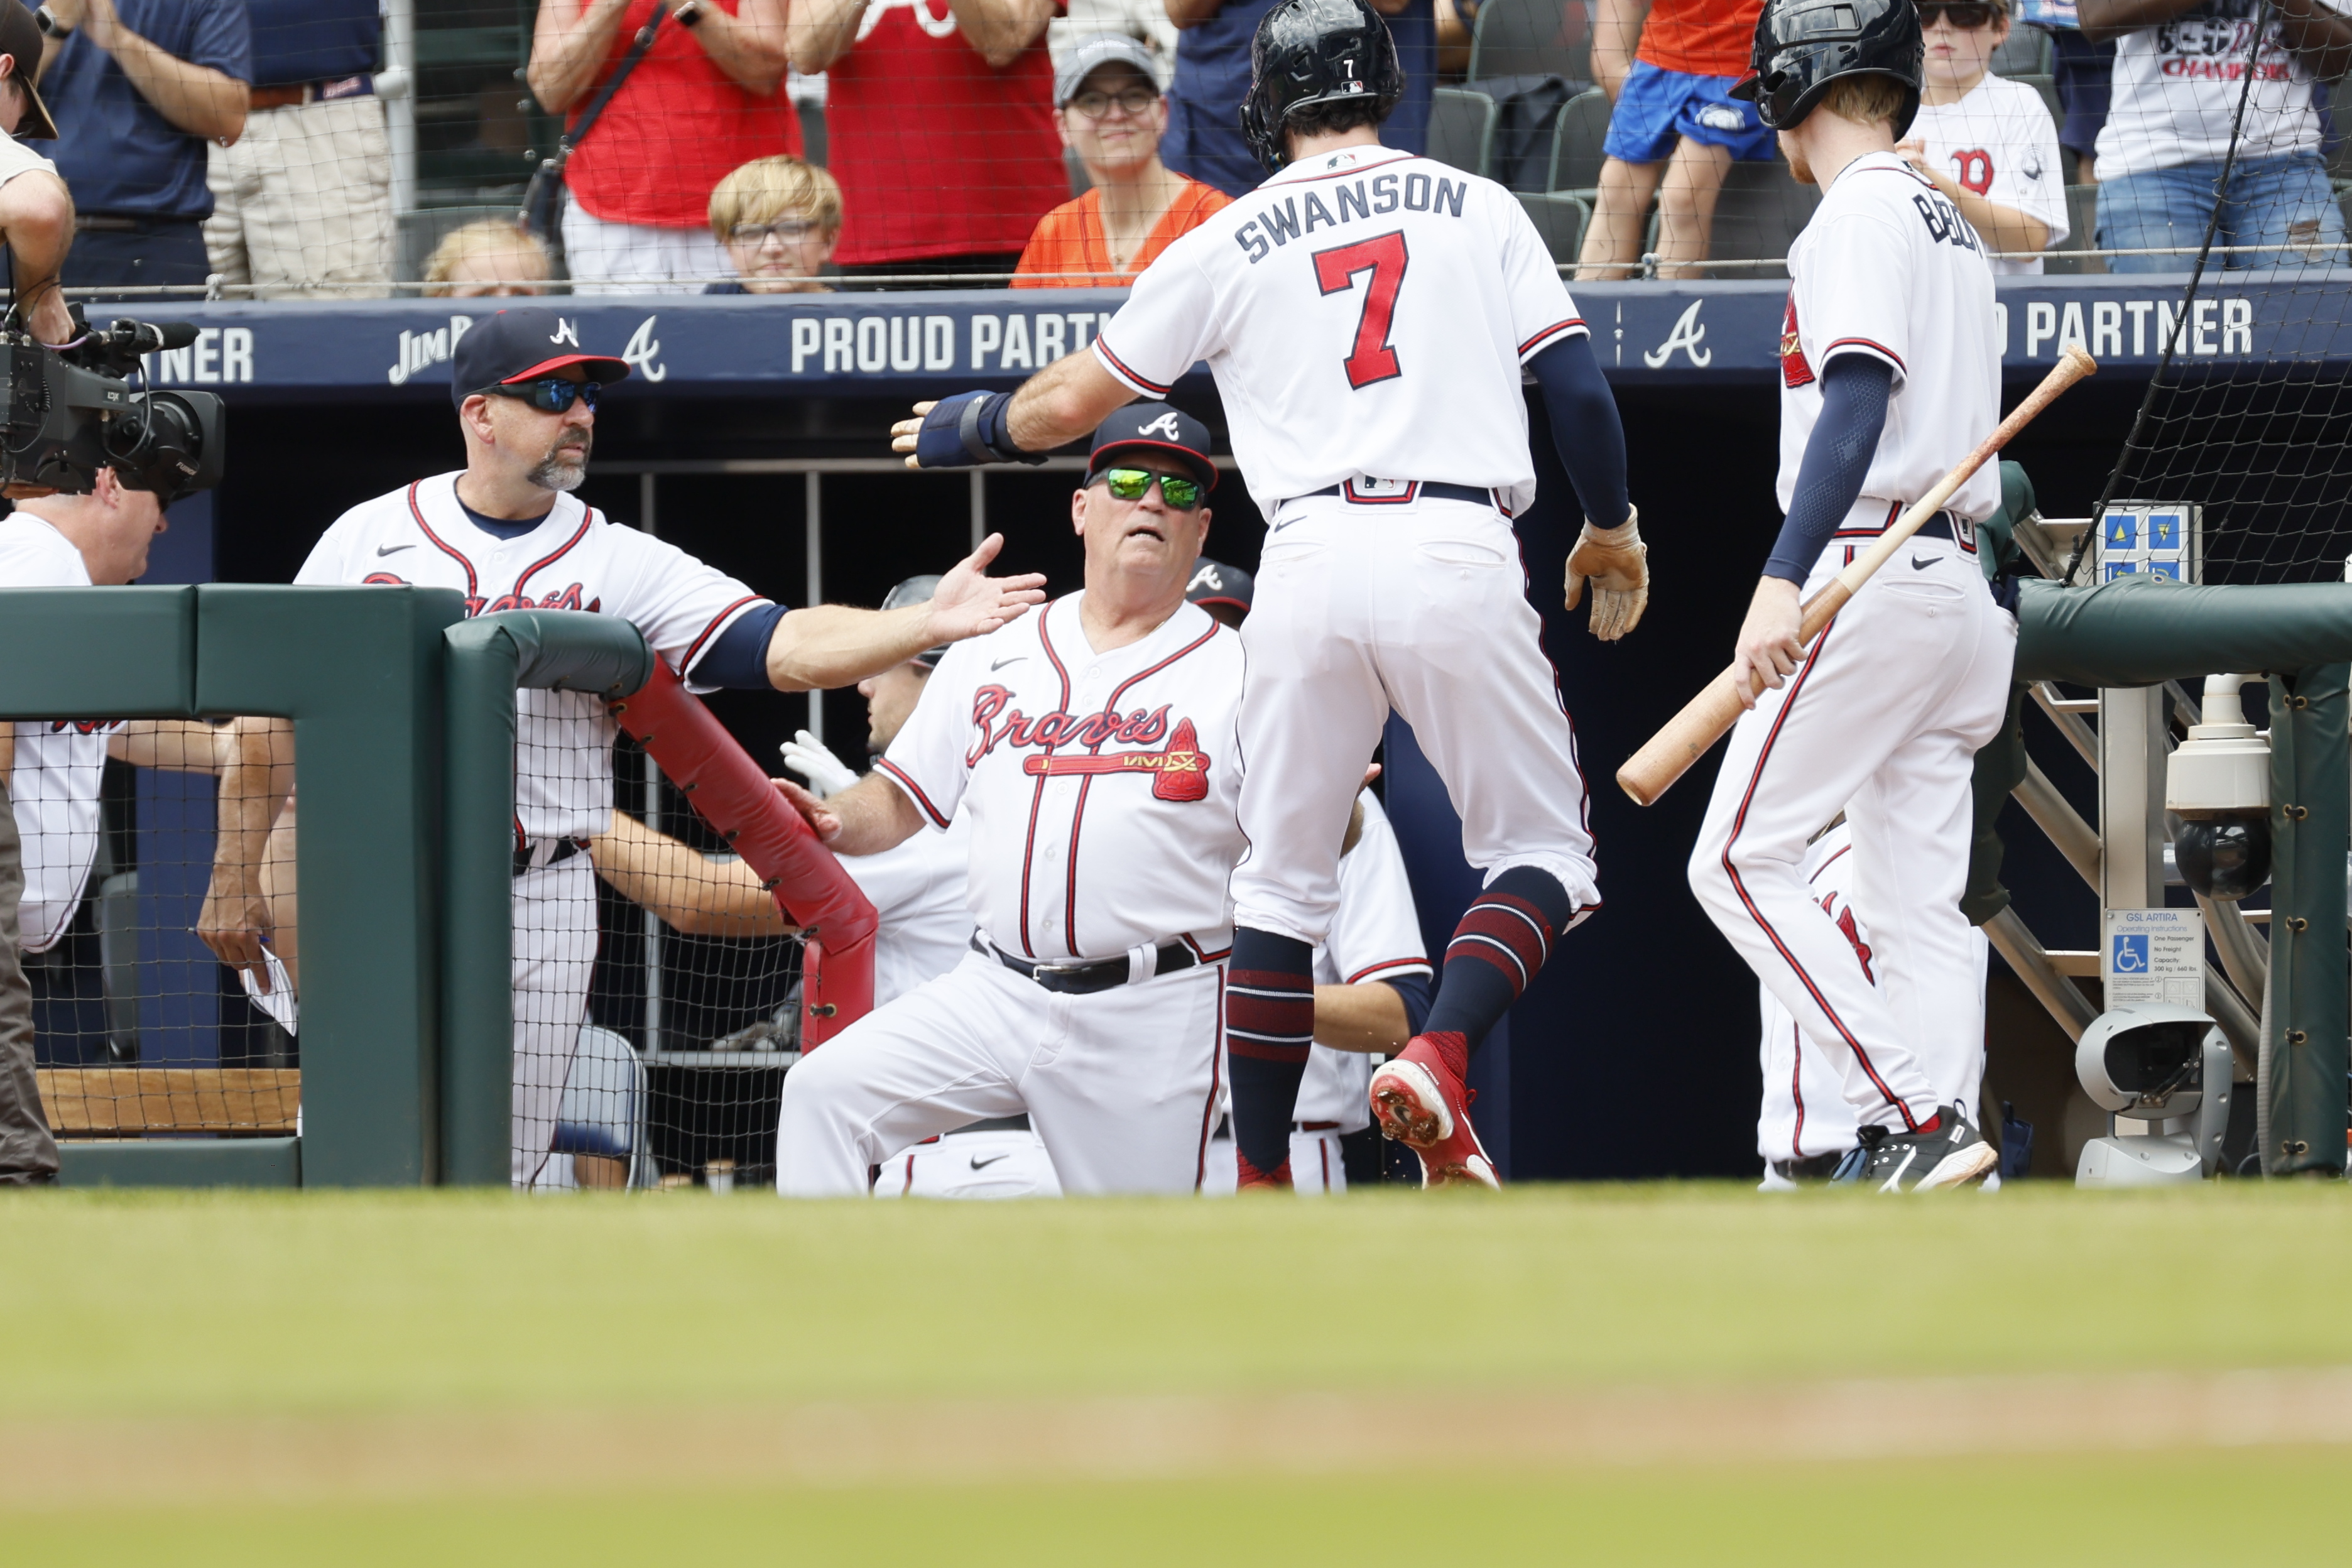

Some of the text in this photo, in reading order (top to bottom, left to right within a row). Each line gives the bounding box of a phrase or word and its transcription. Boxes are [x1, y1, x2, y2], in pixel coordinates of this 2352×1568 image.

[1344, 59, 1353, 79] 7
[1234, 173, 1467, 264] SWANSON
[1310, 228, 1409, 391] 7
[2027, 298, 2253, 357] PARTNER
[792, 313, 1114, 373] PROUD PART
[966, 683, 1173, 768] Braves
[2116, 925, 2150, 933] Operating
[2126, 913, 2178, 922] GSL ARTIRA
